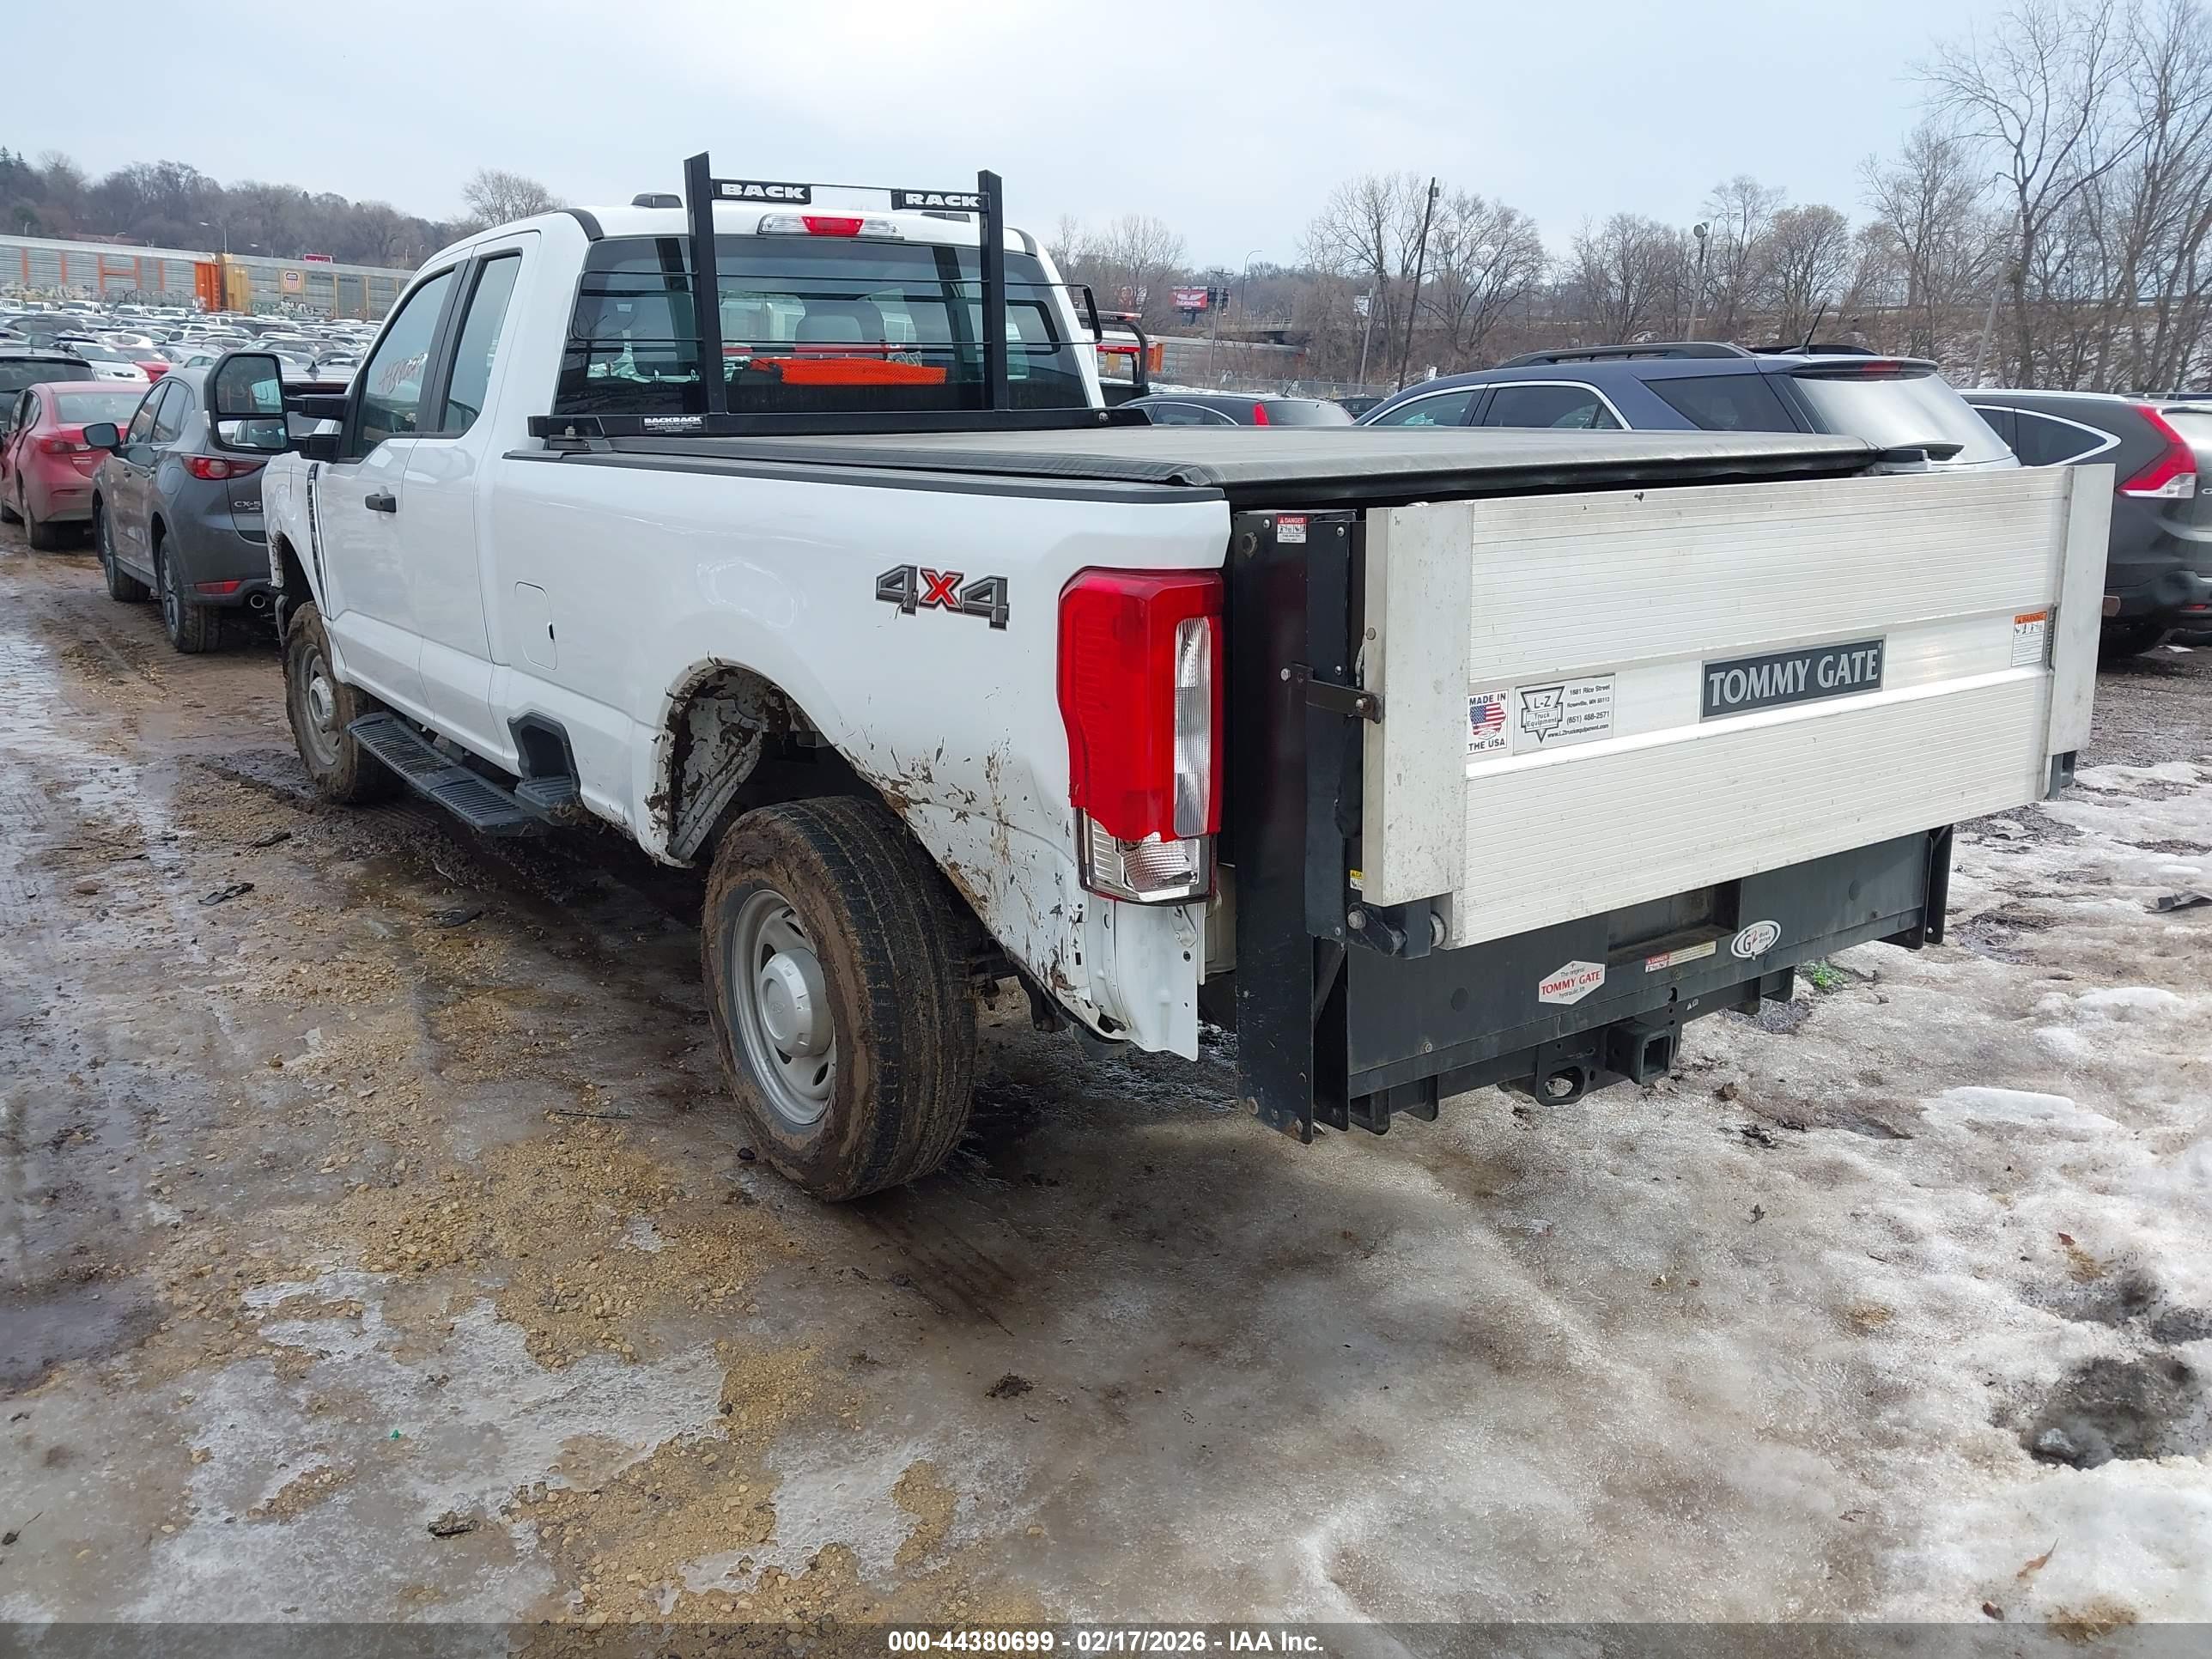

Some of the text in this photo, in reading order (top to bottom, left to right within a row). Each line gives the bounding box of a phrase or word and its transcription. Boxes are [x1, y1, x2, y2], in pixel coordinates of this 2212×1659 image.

[720, 183, 805, 200] BACK
[904, 191, 981, 208] RACK
[1709, 649, 1879, 707] TOMMY GATE
[1469, 692, 1506, 706] MADE IN
[1534, 695, 1552, 709] L-Z
[1527, 717, 1558, 728] Equipment
[1534, 712, 1550, 720] Truck
[1566, 714, 1582, 726] (651)
[1468, 738, 1505, 752] THE USA
[1540, 970, 1601, 995] TOMMY GATE
